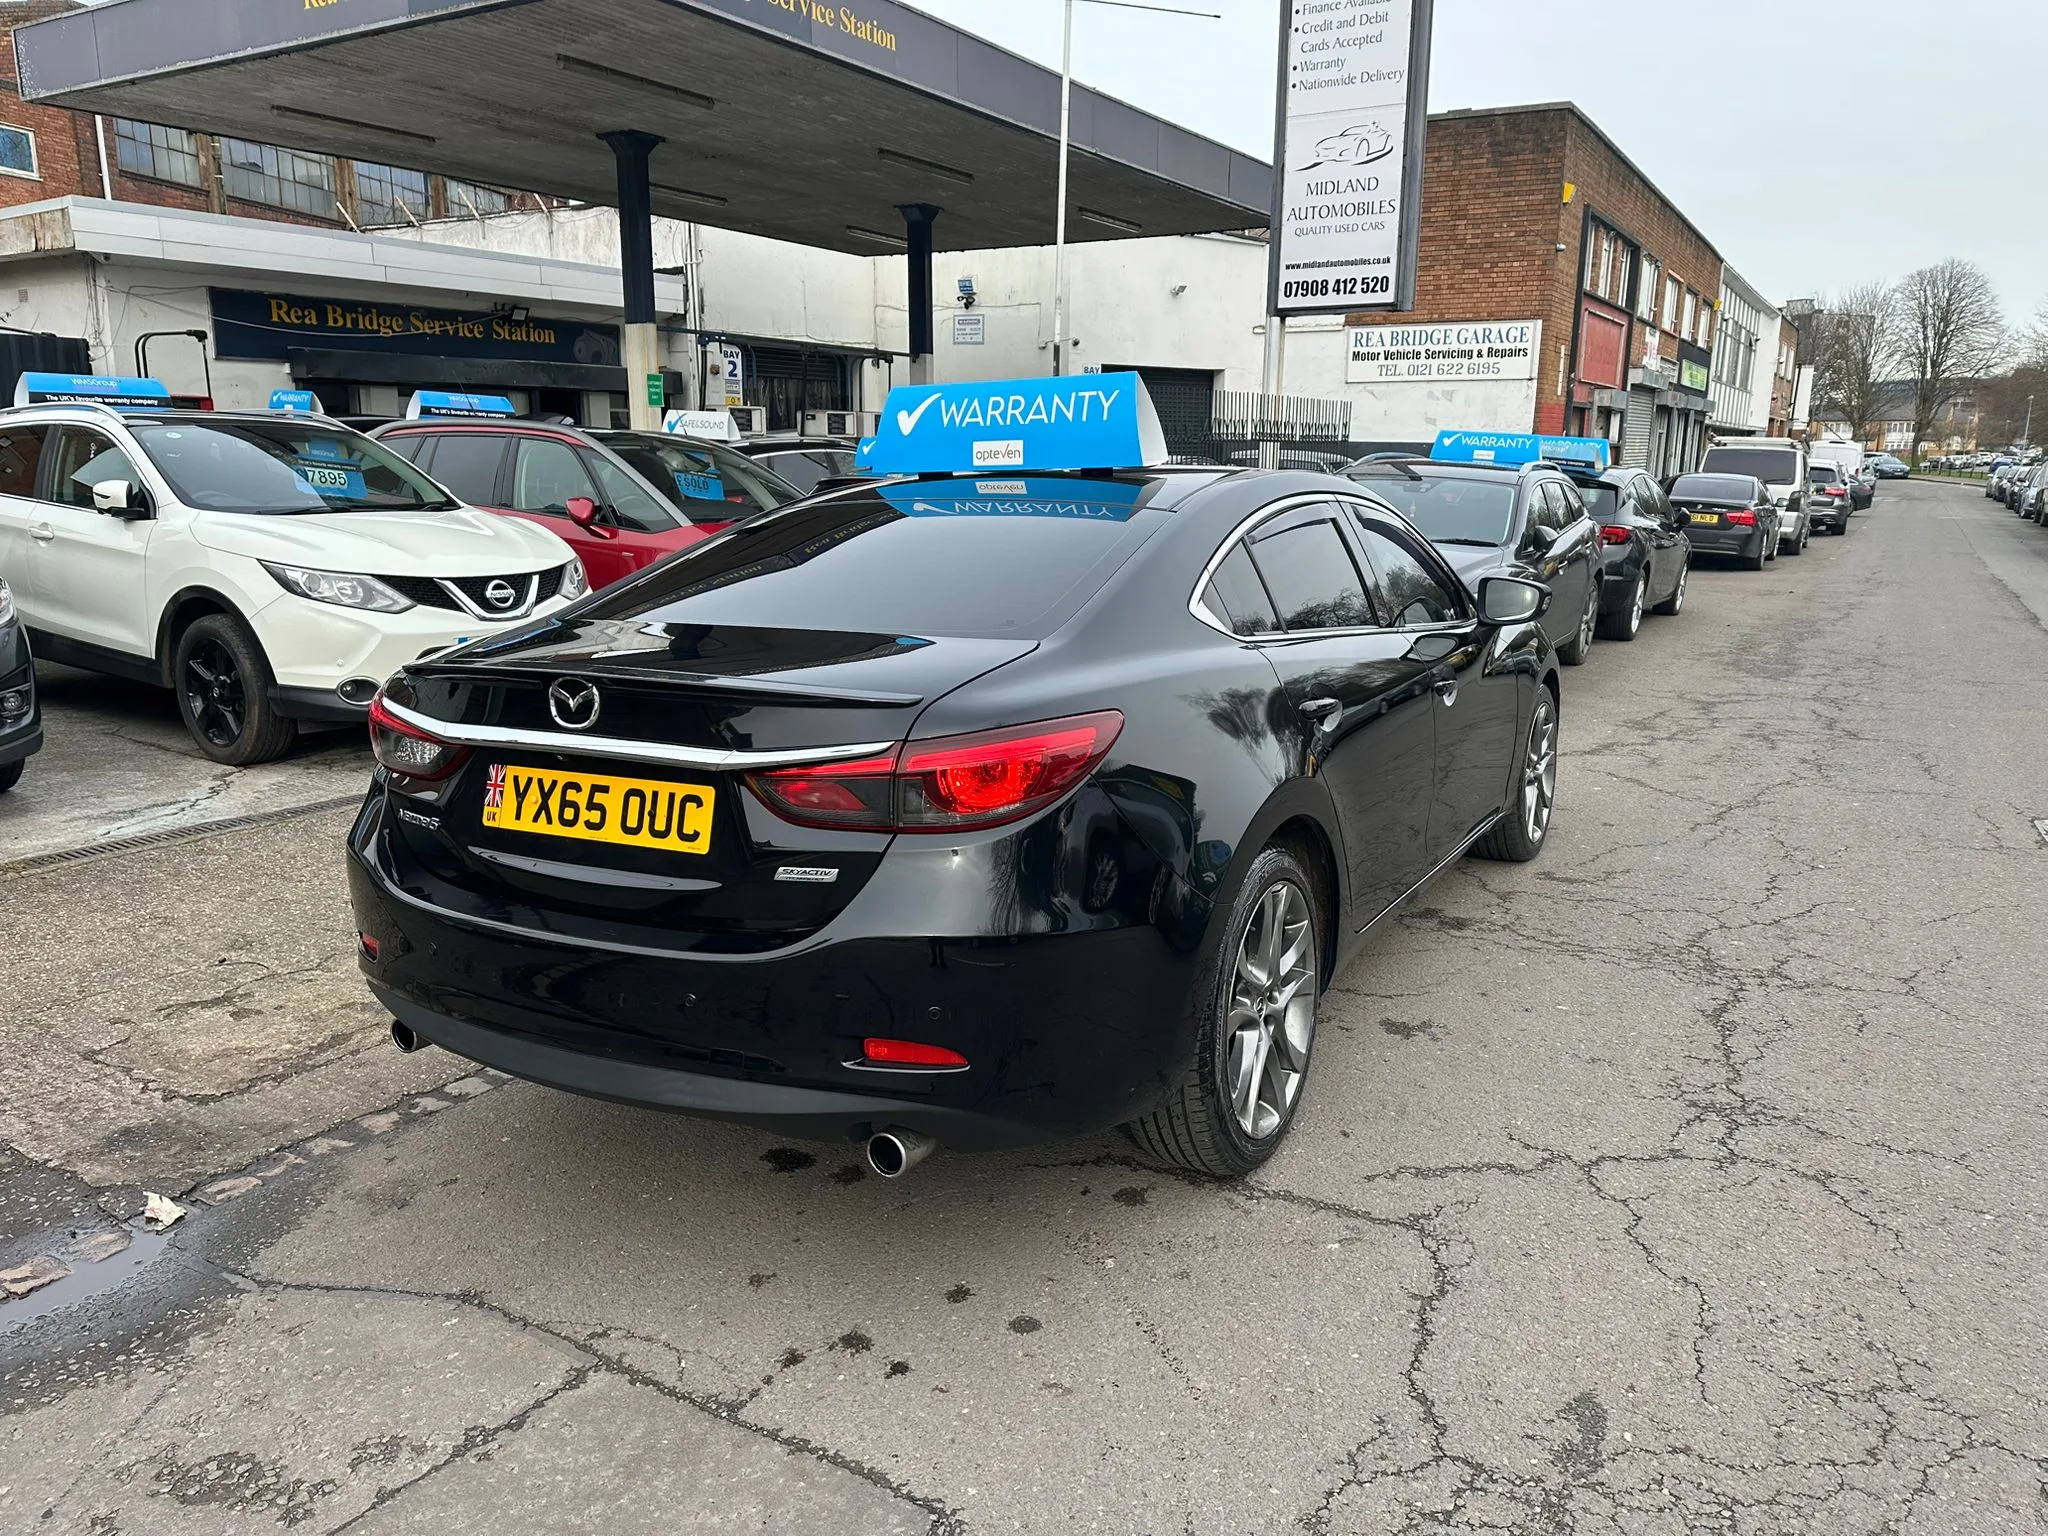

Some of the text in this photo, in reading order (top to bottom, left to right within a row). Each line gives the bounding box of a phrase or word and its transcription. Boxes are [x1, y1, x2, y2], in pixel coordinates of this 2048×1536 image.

[1302, 1, 1342, 15] Finance
[767, 0, 897, 52] ervice Station
[1301, 11, 1389, 34] Credit and Debit
[1300, 30, 1383, 53] Cards Accepted
[1300, 57, 1346, 72] Warranty
[1299, 69, 1405, 91] Nationwide Delivery
[1305, 176, 1379, 197] MIDLAND
[1286, 199, 1396, 222] AUTOMOBILES
[1294, 221, 1385, 237] QUALITY USED CARS
[1285, 256, 1391, 270] www.midlandautomobiles.co.uk
[1283, 275, 1390, 298] 07908 412 520
[268, 299, 556, 345] Rea Bridge Service Station
[1353, 326, 1530, 348] REA BRIDGE GARAGE
[723, 350, 740, 359] BAY
[1352, 346, 1528, 362] Motor Vehicle Servicing & Repairs
[727, 359, 738, 378] 2
[1083, 366, 1101, 375] BAY
[1377, 361, 1501, 377] TEL. 0121 622 6195
[940, 388, 1120, 428] WARRANTY
[975, 442, 1021, 461] opteven
[1461, 435, 1534, 449] WARRANTY
[684, 477, 709, 491] SOLD
[486, 810, 497, 823] UK
[513, 774, 704, 843] YX65 OUC
[782, 868, 832, 876] SKYACTIV
